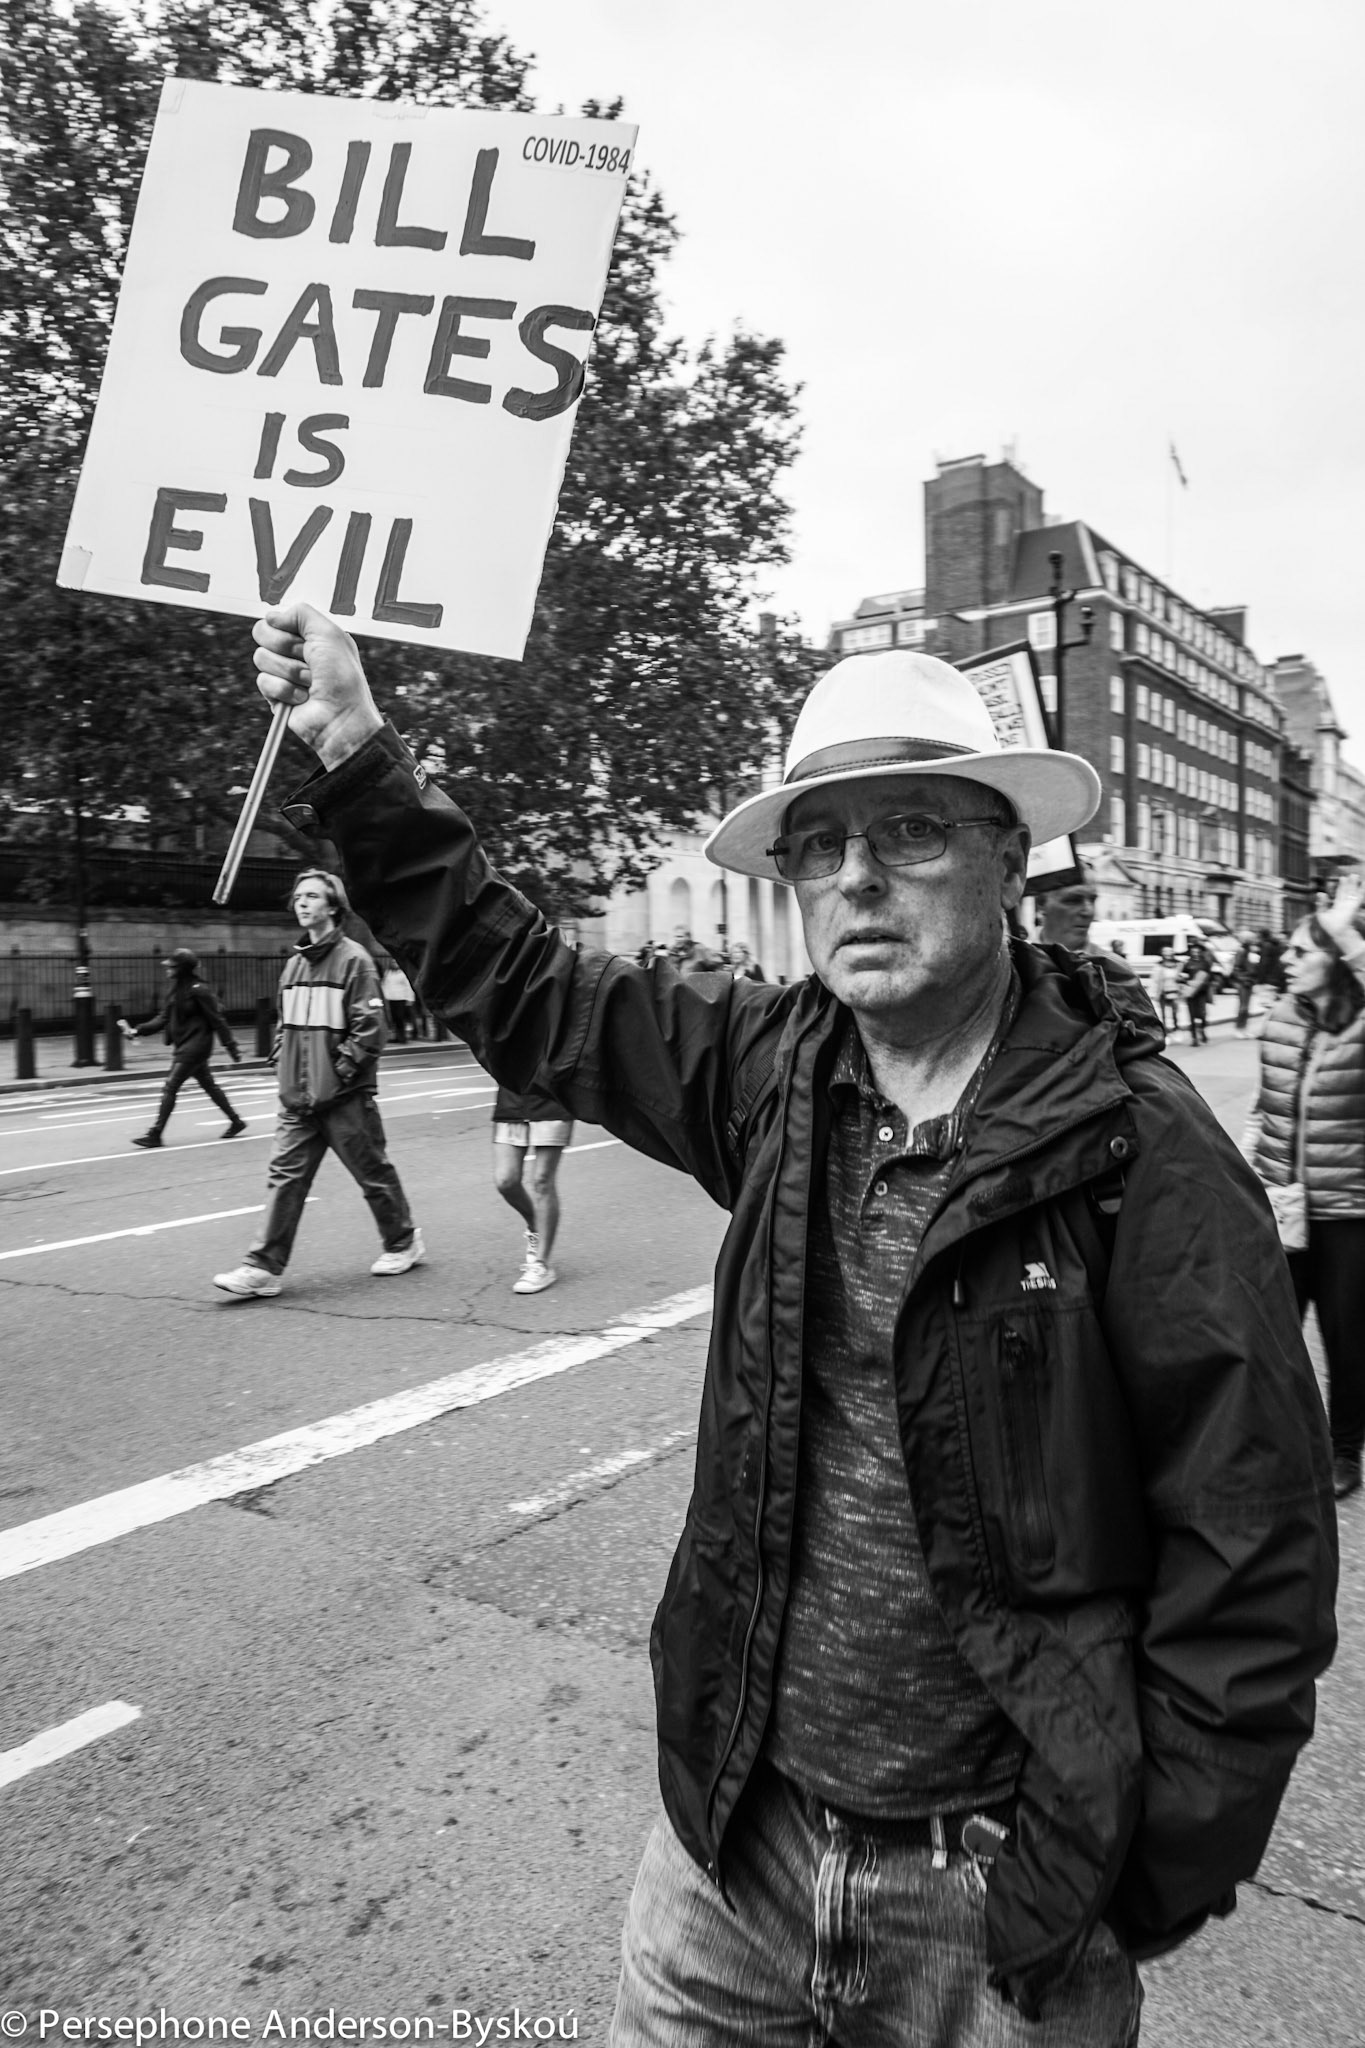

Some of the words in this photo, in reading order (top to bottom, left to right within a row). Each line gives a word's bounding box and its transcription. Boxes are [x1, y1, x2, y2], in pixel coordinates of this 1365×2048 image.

[232, 128, 536, 261] BILL
[522, 135, 631, 175] COVID-1984
[180, 276, 596, 421] GATES
[253, 412, 350, 488] IS
[140, 487, 444, 628] EVIL
